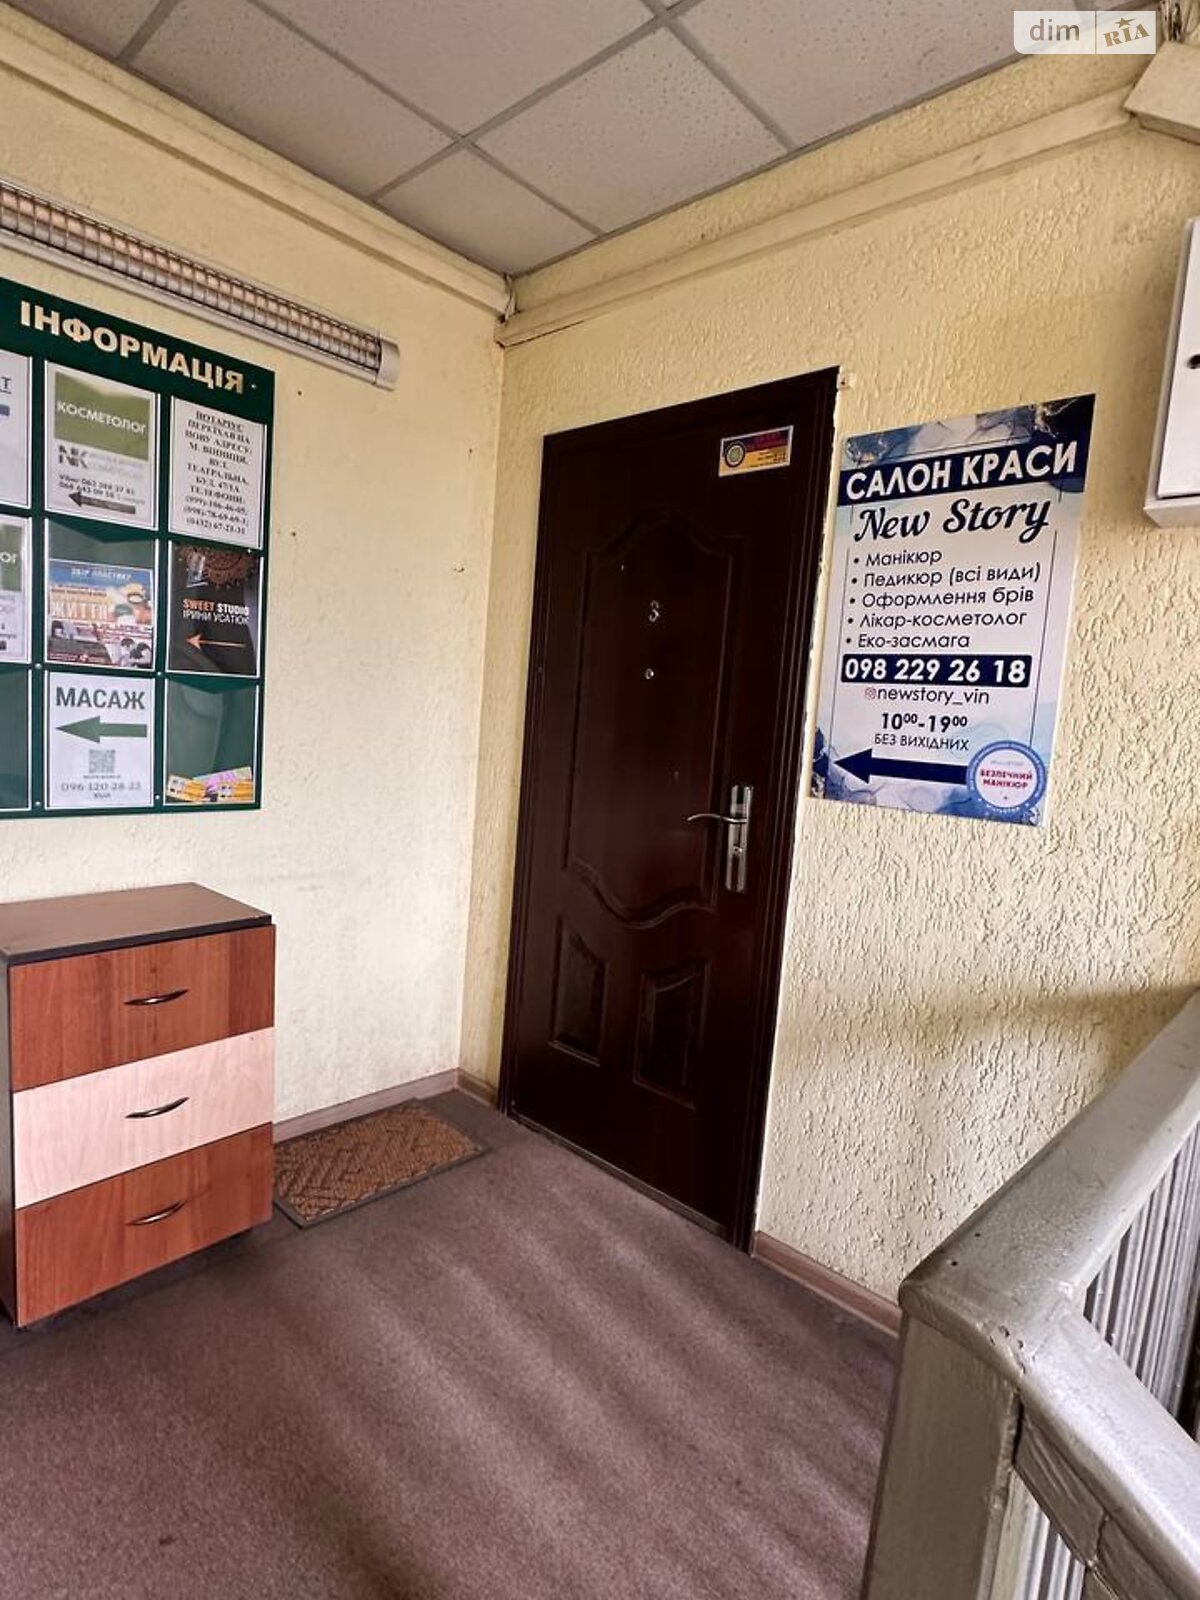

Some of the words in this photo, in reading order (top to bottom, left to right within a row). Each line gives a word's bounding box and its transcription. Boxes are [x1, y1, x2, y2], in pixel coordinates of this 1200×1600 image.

[20, 301, 245, 394] ІНФОРМАЦІЯ
[57, 400, 147, 434] КОСМЕТОЛОГ
[846, 460, 951, 501] САЛОН
[962, 441, 1078, 486] КРАСИ
[854, 507, 930, 542] New
[943, 498, 1051, 544] Story
[866, 549, 943, 568] Манікюр
[863, 570, 943, 588] Педикюр
[948, 566, 983, 586] (всі
[987, 562, 1041, 583] види)
[183, 598, 215, 612] SWEET
[216, 602, 250, 616] STUDIO
[862, 589, 987, 608] Оформлення
[992, 587, 1035, 606] брів
[859, 612, 1028, 630] Лікар-косметолог
[858, 634, 971, 650] Еко-засмага
[845, 658, 888, 680] 098
[894, 660, 941, 682] 229
[947, 660, 981, 683] 26
[993, 660, 1027, 684] 18
[56, 686, 146, 710] МАСАЖ
[876, 686, 990, 706] newstory_vin
[874, 733, 897, 746] БЕЗ
[900, 735, 970, 751] ВИХІДНИХ
[980, 769, 1033, 780] БЕЗПЕЧНИЙ
[983, 779, 1029, 788] МАНІКЮР
